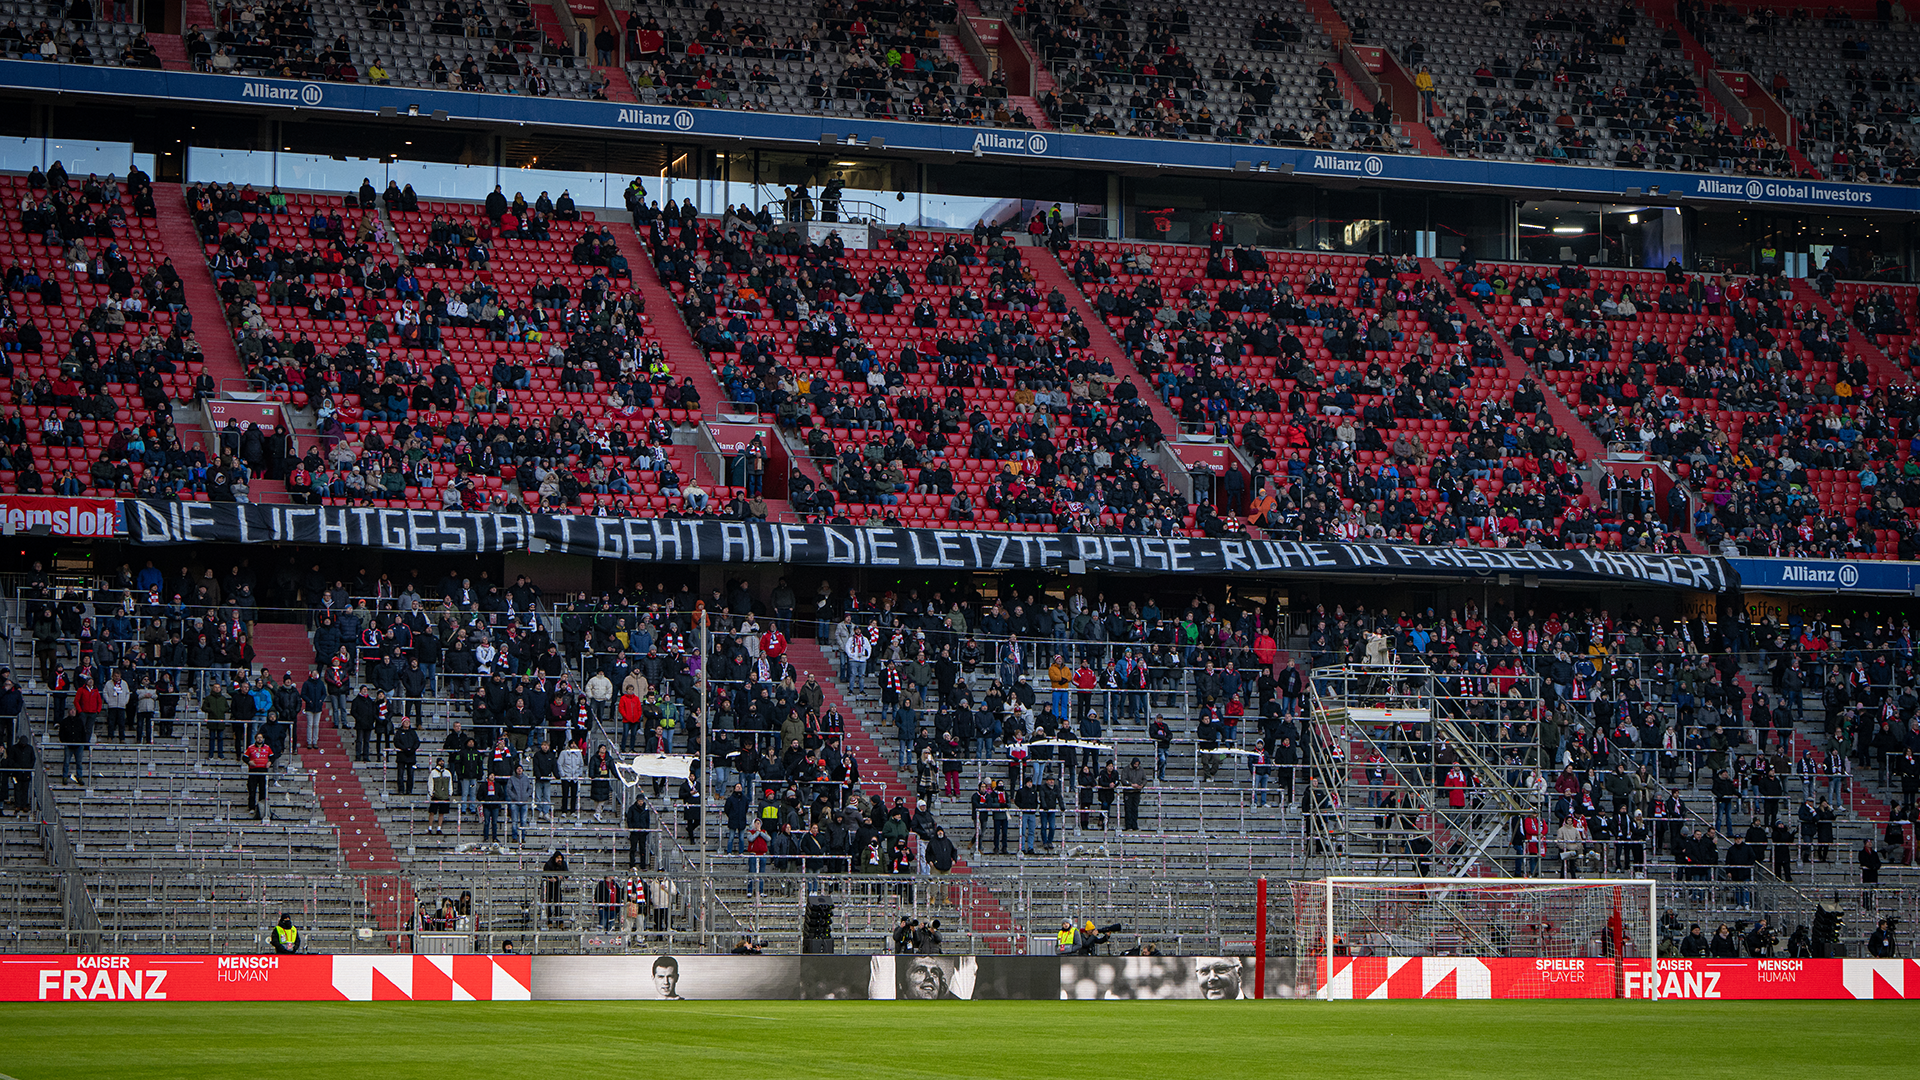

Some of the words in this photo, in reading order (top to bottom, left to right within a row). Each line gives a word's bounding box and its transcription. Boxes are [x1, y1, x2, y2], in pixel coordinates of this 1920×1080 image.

[242, 83, 298, 100] Allianz
[617, 108, 670, 126] Allianz
[974, 132, 1024, 150] Allianz
[1313, 155, 1361, 171] Allianz
[1697, 179, 1743, 194] Allianz
[1766, 183, 1808, 199] Global
[1811, 186, 1872, 202] Investors
[135, 500, 214, 542] DIE
[595, 516, 704, 561] GEHT
[720, 521, 808, 563] AUF
[823, 526, 899, 565] DIE
[1220, 540, 1337, 571] RUHE
[1340, 544, 1388, 566] IN
[1782, 565, 1836, 583] Allianz
[76, 956, 130, 969] KAISER
[218, 956, 279, 969] MENSCH
[1535, 959, 1585, 971] SPIELER
[1757, 959, 1802, 971] MENSCH
[218, 970, 269, 982] HUMAN
[1542, 971, 1585, 982] PLAYER
[1757, 971, 1796, 982] HUMAN
[38, 970, 168, 1000] FRANZ
[1624, 972, 1721, 998] FRANZ
